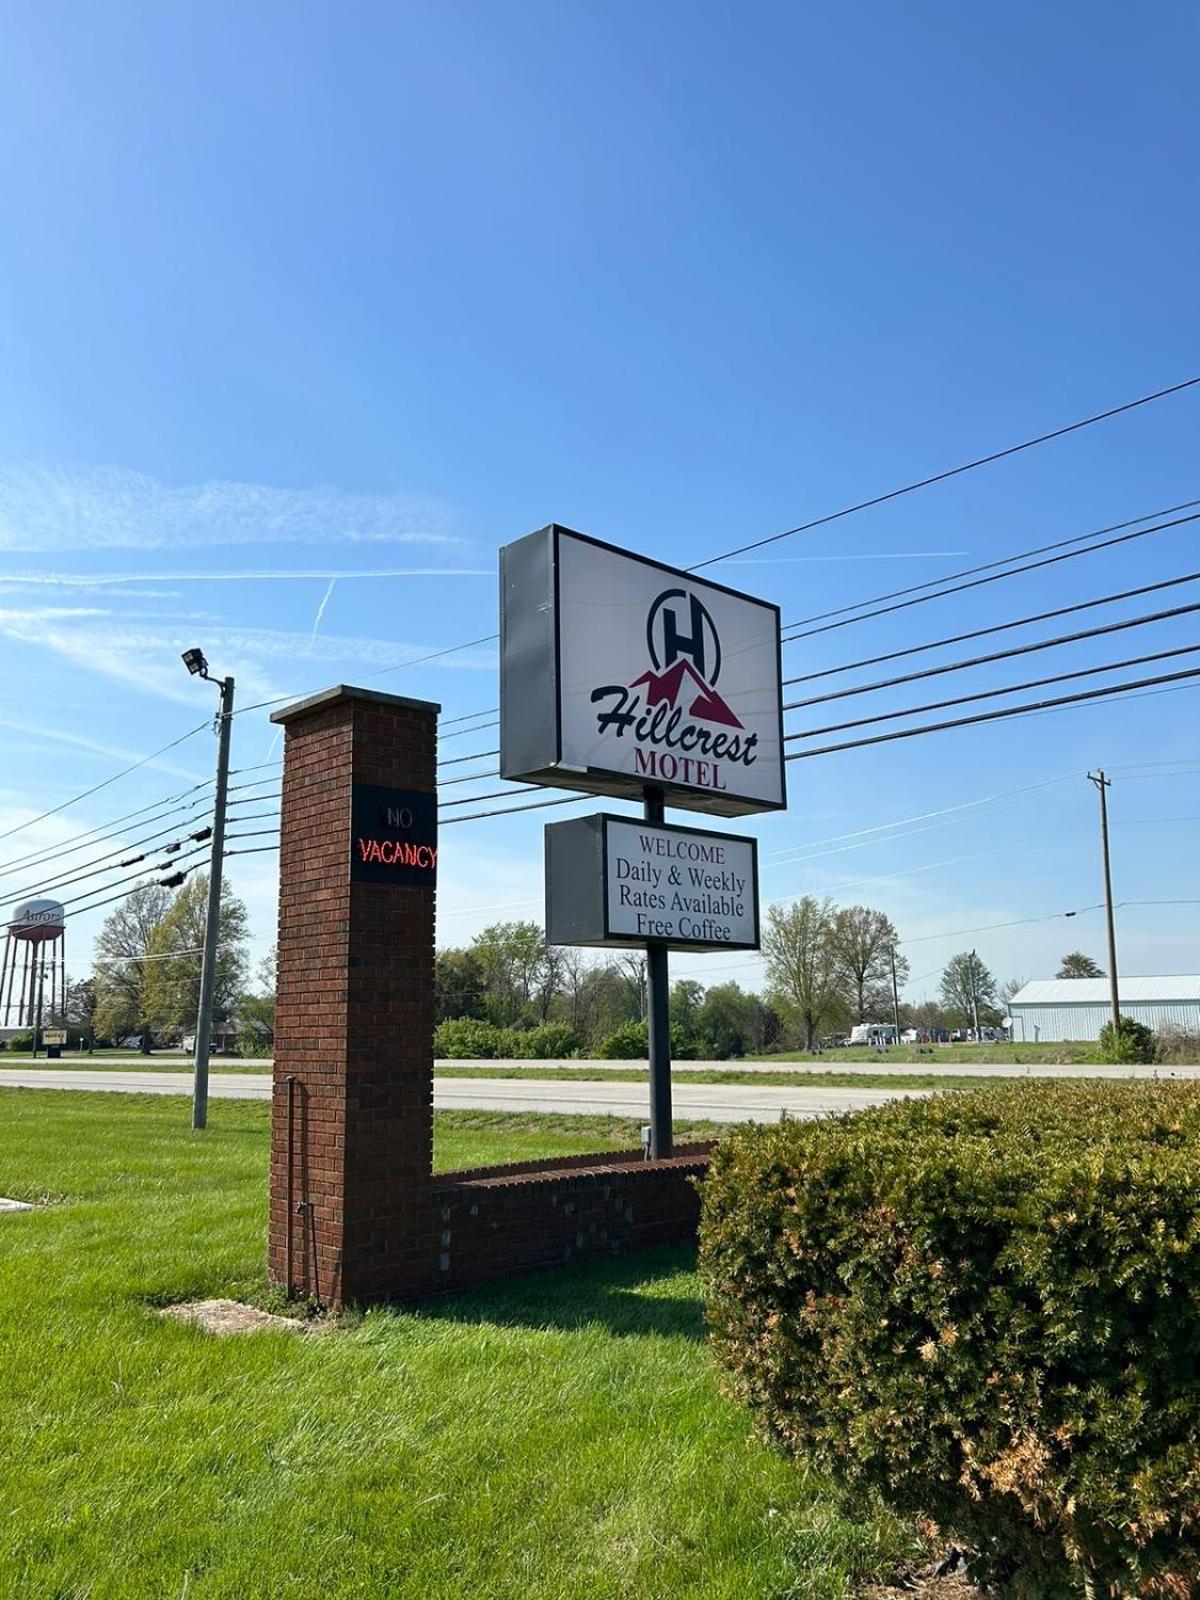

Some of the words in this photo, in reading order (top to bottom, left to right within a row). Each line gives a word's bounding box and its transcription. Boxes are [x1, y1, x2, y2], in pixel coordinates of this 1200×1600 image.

[663, 592, 705, 679] H
[591, 686, 758, 766] Hillcrest
[633, 747, 727, 790] MOTEL
[387, 807, 413, 828] NO
[359, 838, 439, 869] VACANCY
[640, 835, 725, 864] WELCOME
[616, 858, 662, 888] Daily
[667, 865, 682, 886] &
[688, 867, 746, 897] Weekly
[619, 884, 665, 909] Rates
[670, 892, 744, 917] Available
[636, 913, 674, 936] Free
[678, 917, 731, 940] Coffee
